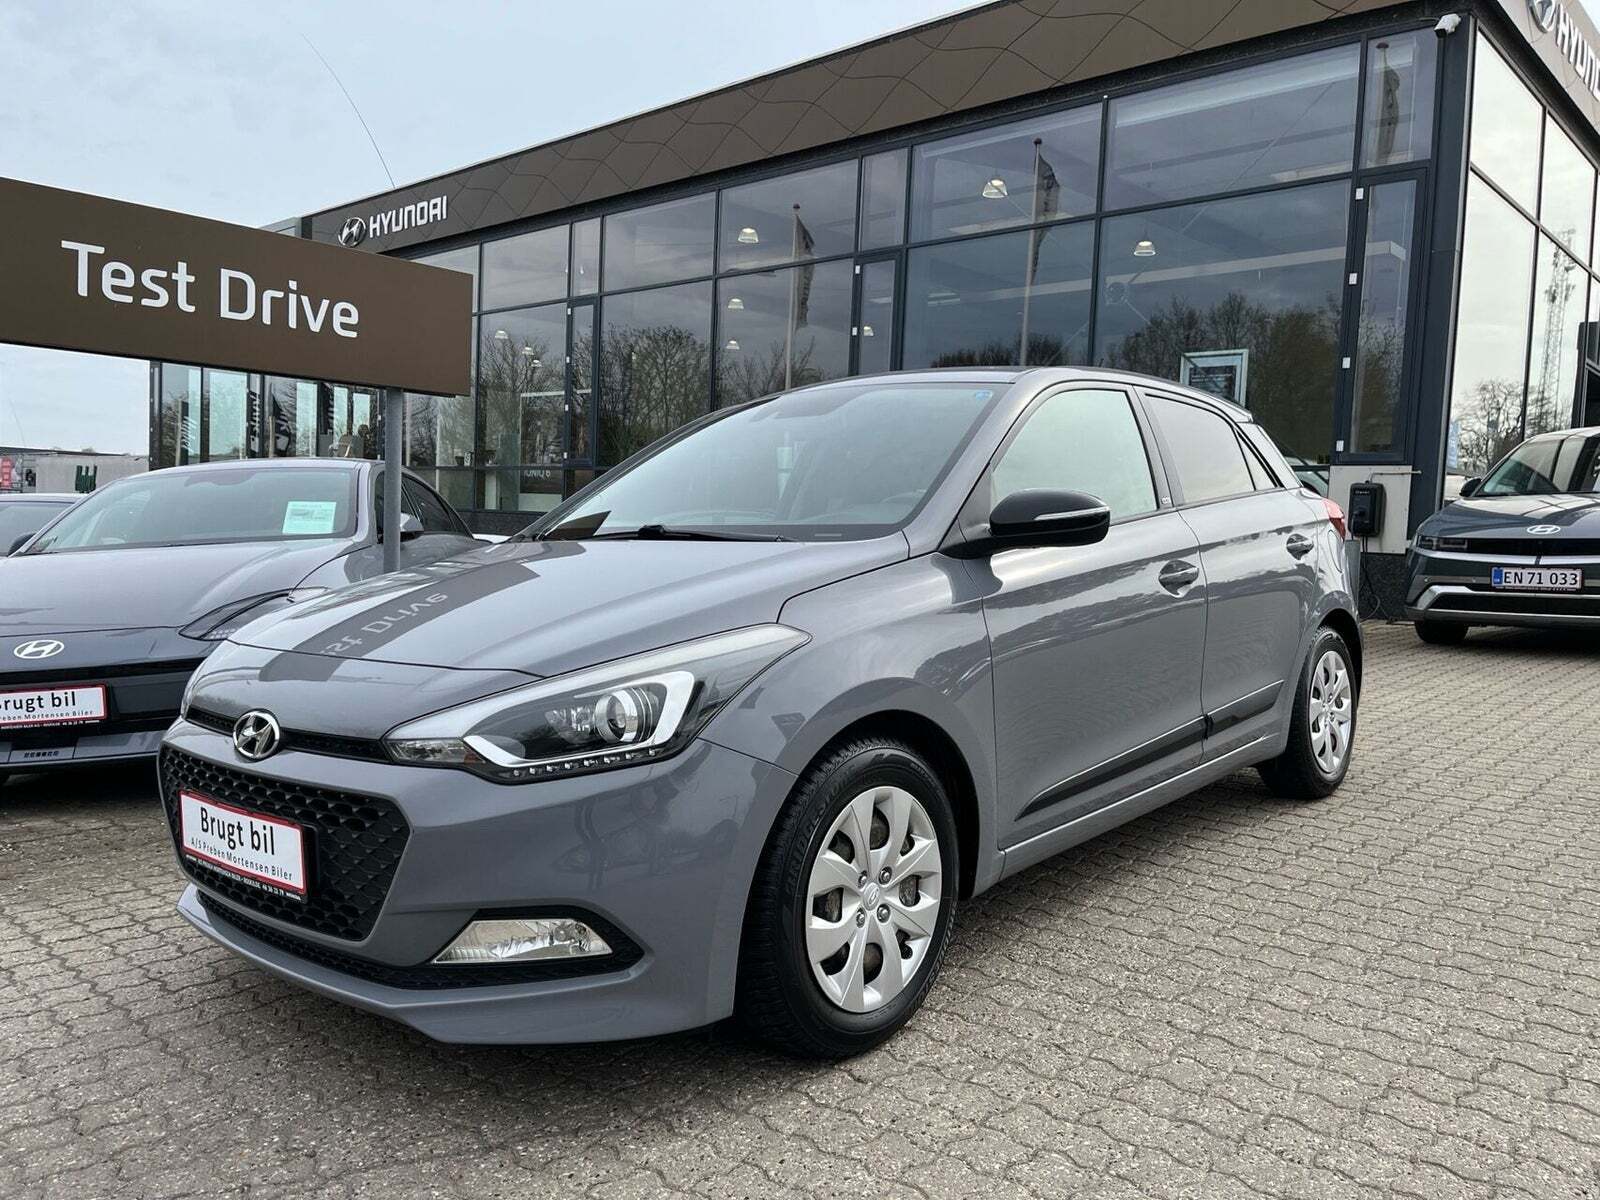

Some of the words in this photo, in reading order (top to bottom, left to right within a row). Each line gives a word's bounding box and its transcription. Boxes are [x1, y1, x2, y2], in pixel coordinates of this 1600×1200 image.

[369, 195, 448, 238] HYUNDAI
[61, 240, 196, 313] Test
[220, 268, 360, 339] Drive
[1504, 571, 1523, 584] EN
[1527, 572, 1543, 584] 71
[1549, 572, 1578, 585] 033
[0, 694, 45, 713] rugt
[51, 691, 76, 707] bil
[24, 711, 70, 720] Mortensen
[72, 709, 94, 717] Biler
[200, 807, 244, 851] Brugt
[250, 821, 275, 855] bil
[191, 837, 202, 851] A/S
[202, 842, 226, 859] Preben
[226, 850, 269, 874] Mortensen
[271, 865, 293, 881] Biler
